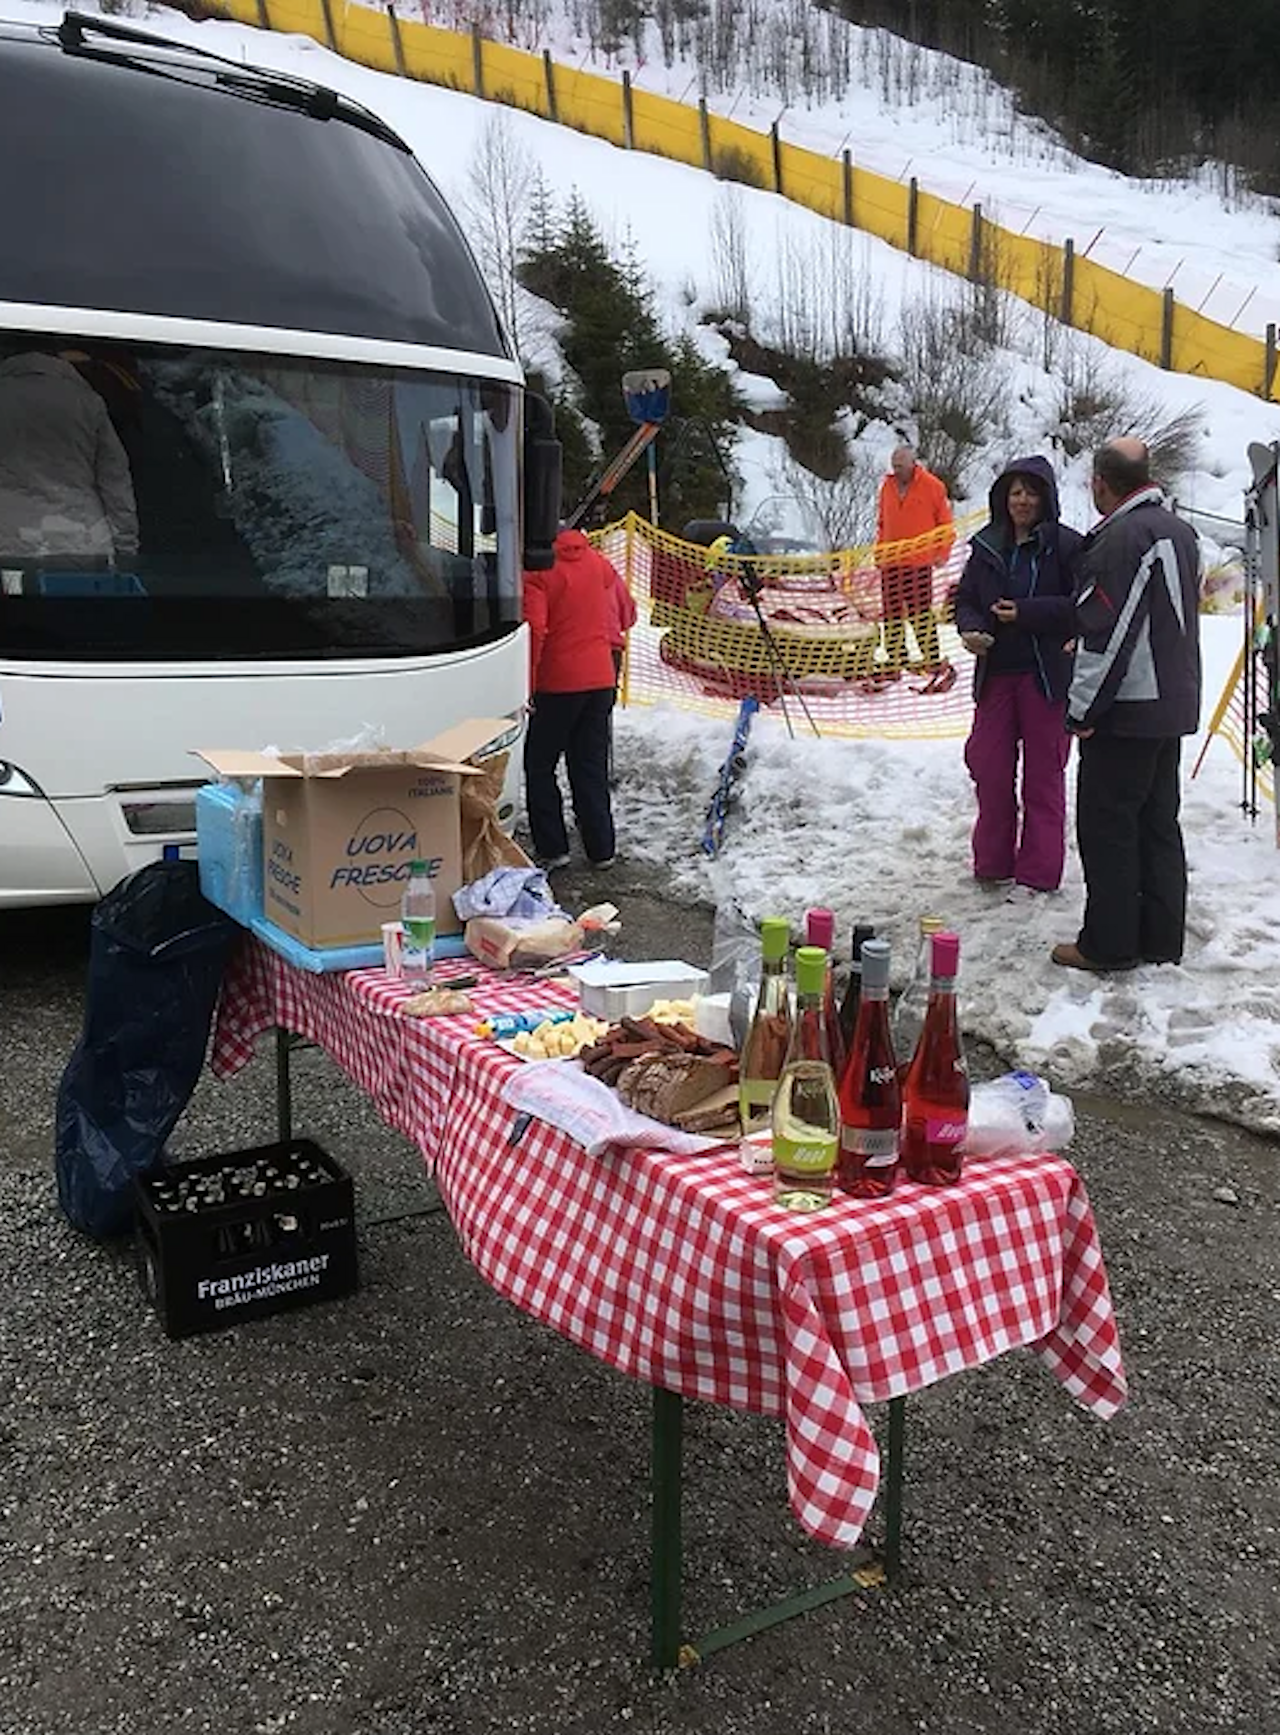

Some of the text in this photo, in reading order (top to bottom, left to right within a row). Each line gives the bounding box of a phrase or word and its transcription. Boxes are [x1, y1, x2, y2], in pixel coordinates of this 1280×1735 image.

[346, 832, 418, 856] UOVA
[330, 857, 443, 889] FRESCE
[197, 1254, 330, 1299] Franziskaner
